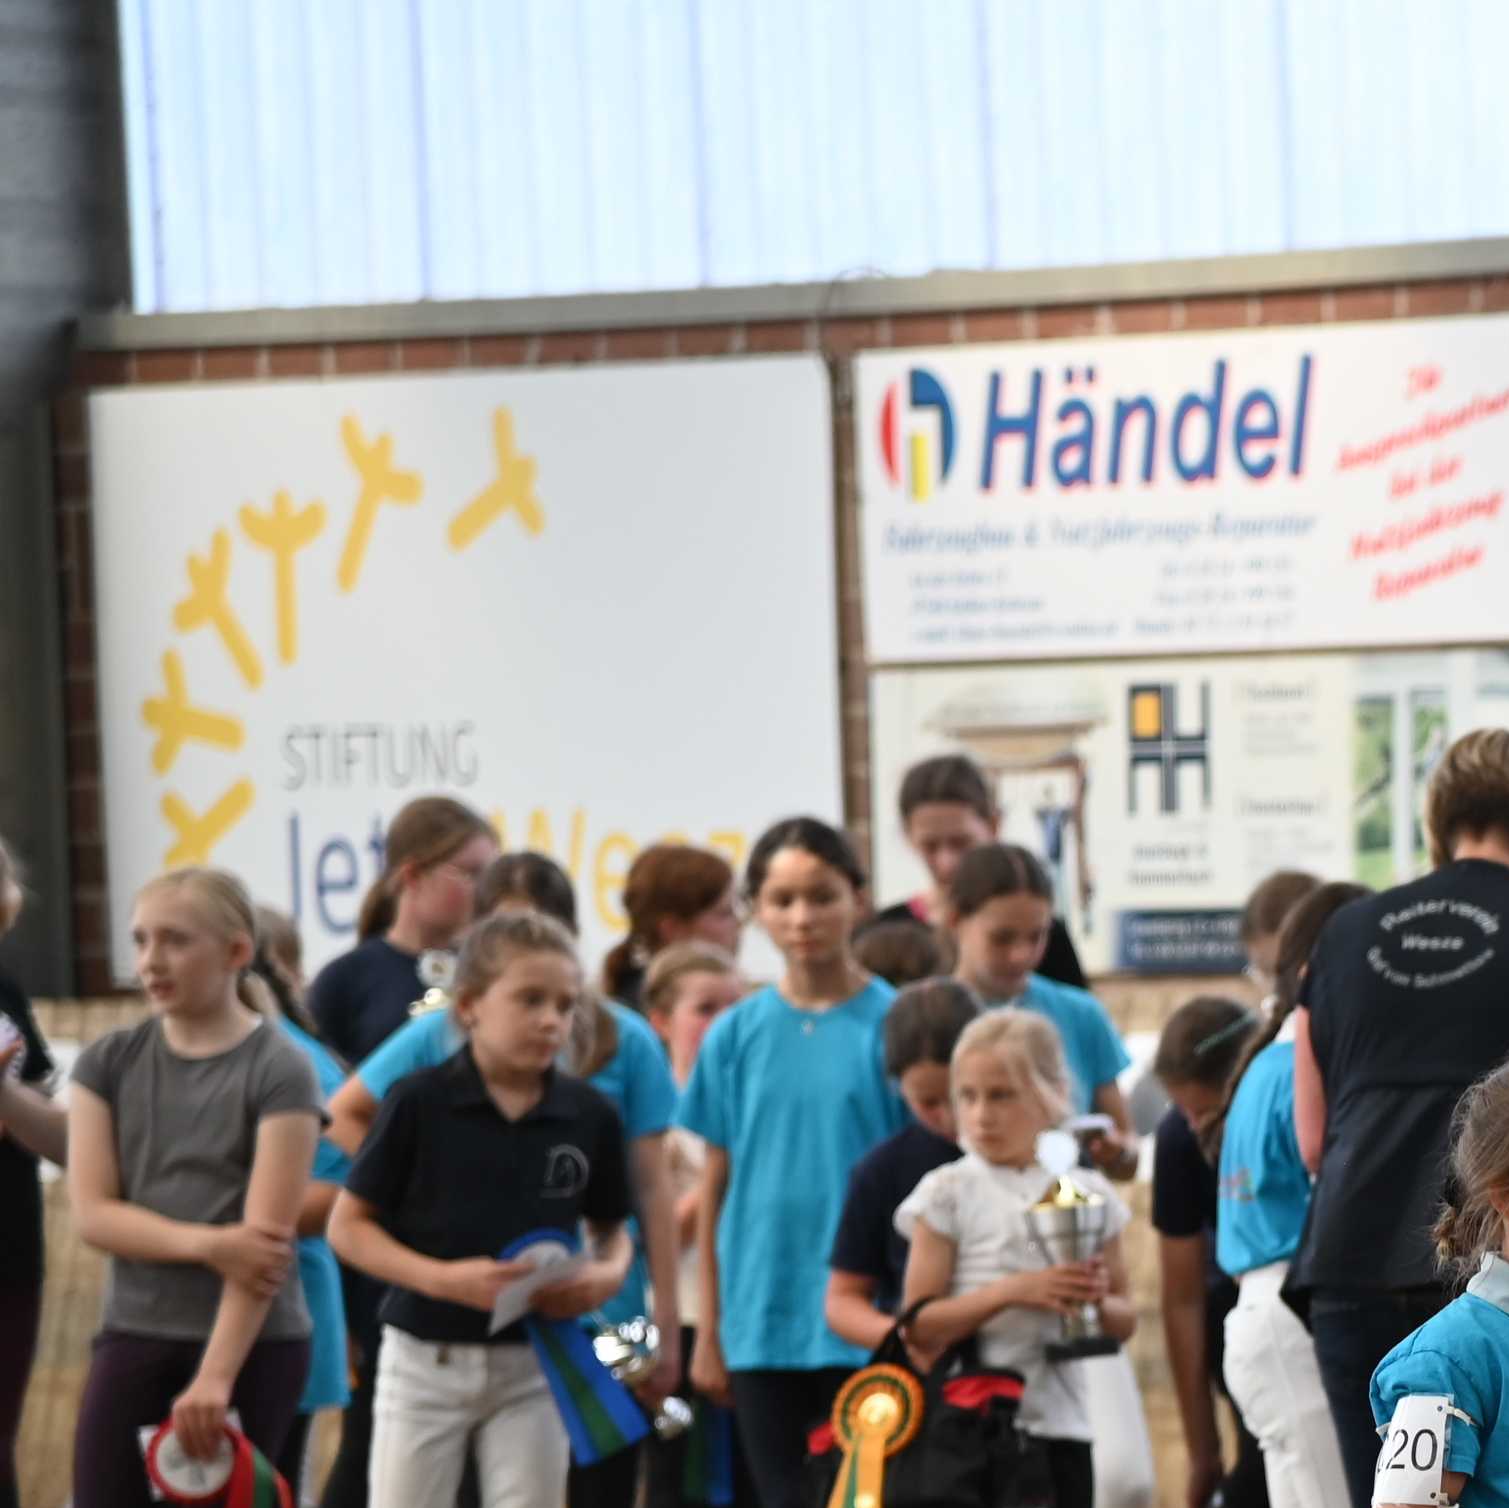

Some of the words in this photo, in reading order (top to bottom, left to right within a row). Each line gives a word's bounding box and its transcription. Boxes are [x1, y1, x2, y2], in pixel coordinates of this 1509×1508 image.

[978, 352, 1315, 491] Händel
[278, 720, 478, 791] STIFTUNG
[1401, 933, 1464, 950] Weeze
[1377, 1428, 1438, 1473] 20
